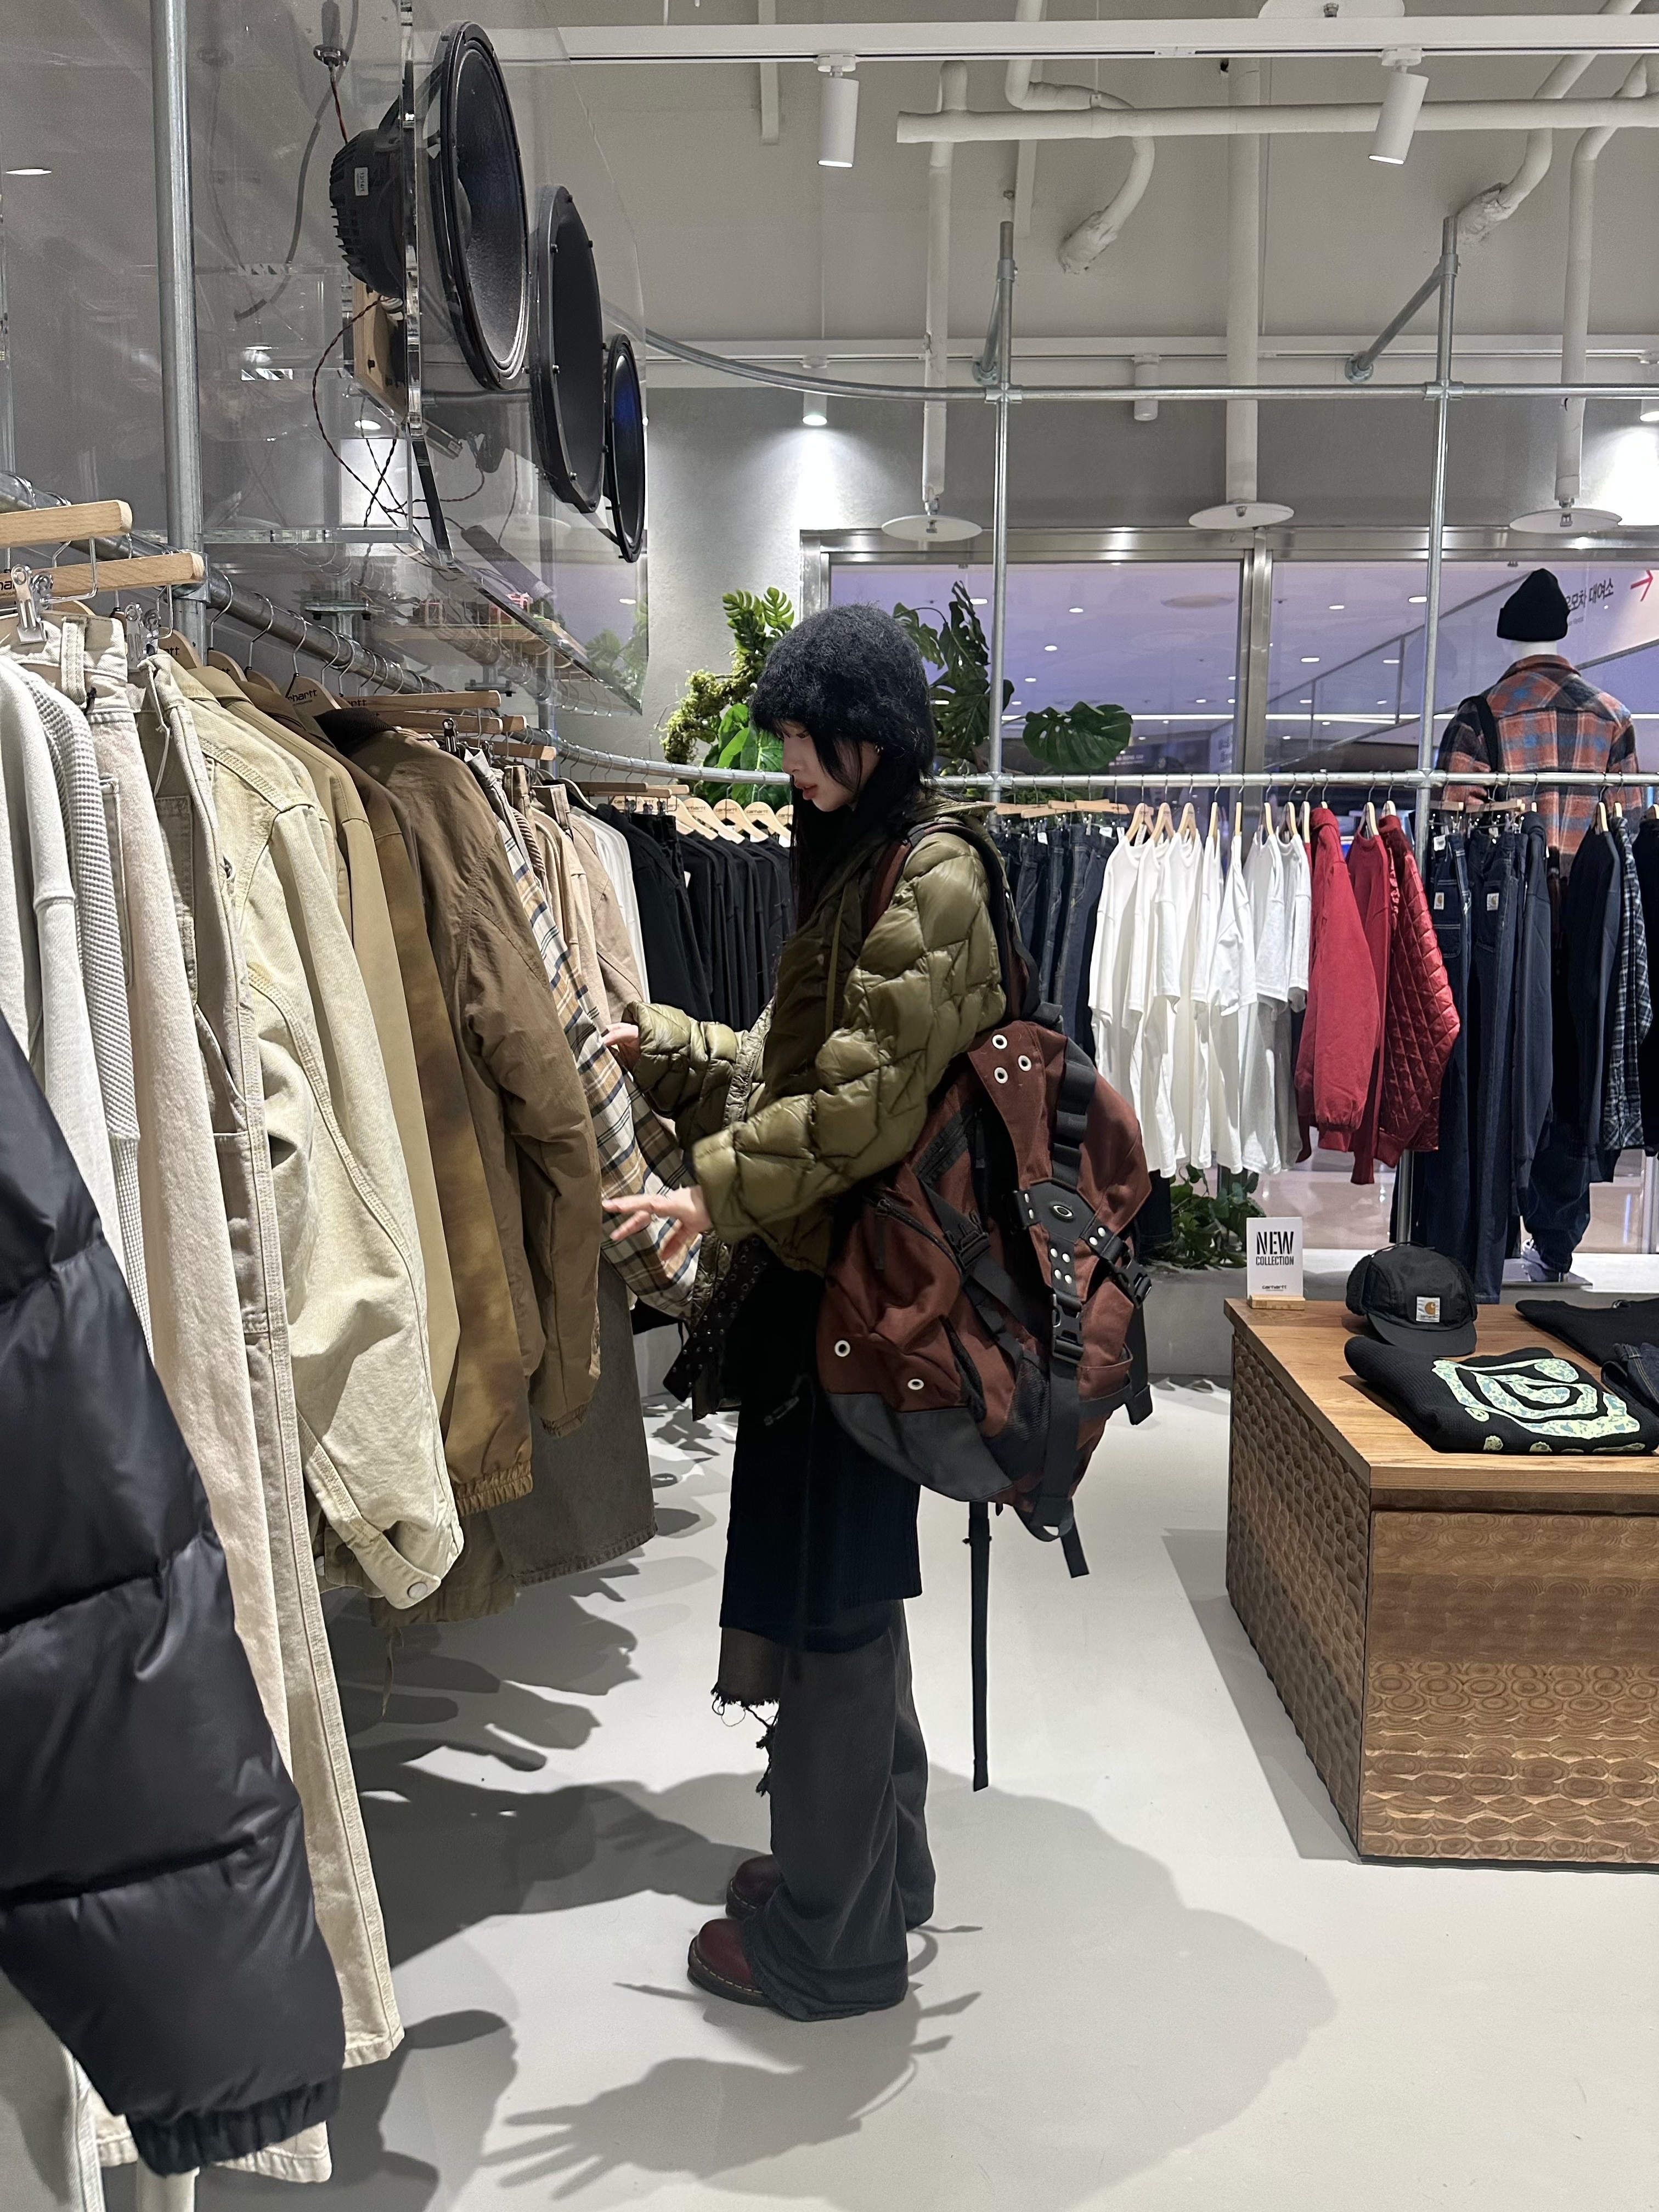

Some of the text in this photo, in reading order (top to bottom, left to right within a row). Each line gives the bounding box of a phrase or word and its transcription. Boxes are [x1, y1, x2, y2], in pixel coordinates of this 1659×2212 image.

[1589, 578, 1613, 603] 대여소
[1257, 1231, 1294, 1254] NEW
[1256, 1256, 1294, 1265] COLLECTION
